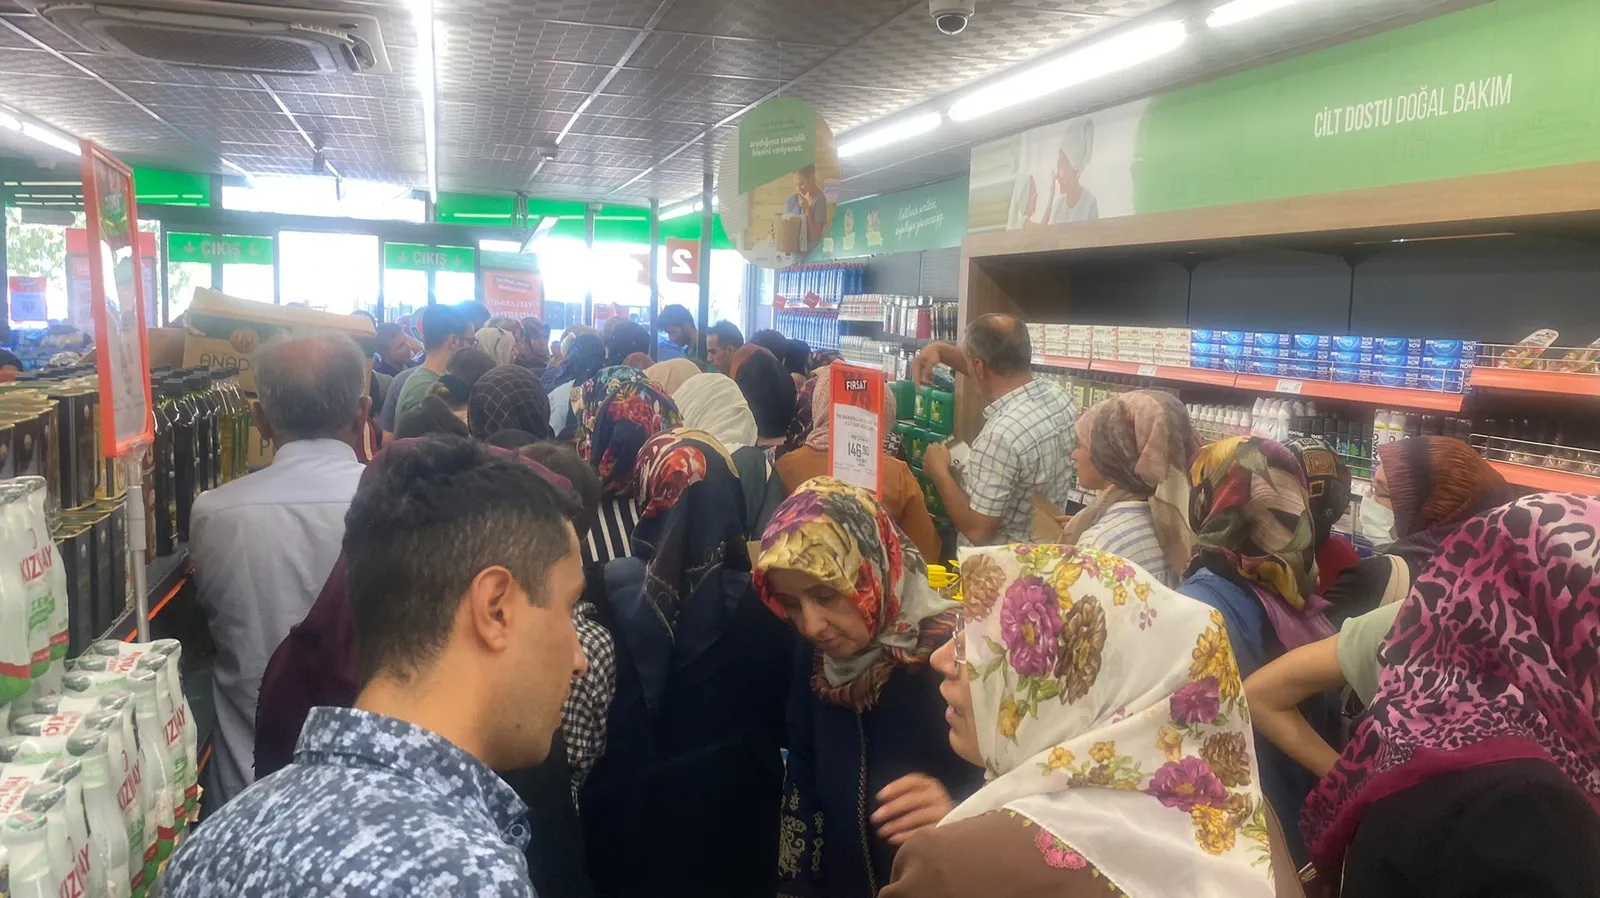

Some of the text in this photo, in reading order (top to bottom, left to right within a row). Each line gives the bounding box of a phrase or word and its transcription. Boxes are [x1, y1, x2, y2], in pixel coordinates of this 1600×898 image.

[1314, 73, 1513, 138] CİLT DOSTU DOĞAL BAKIM
[200, 352, 254, 372] ANAD
[846, 379, 867, 391] FIRSAT
